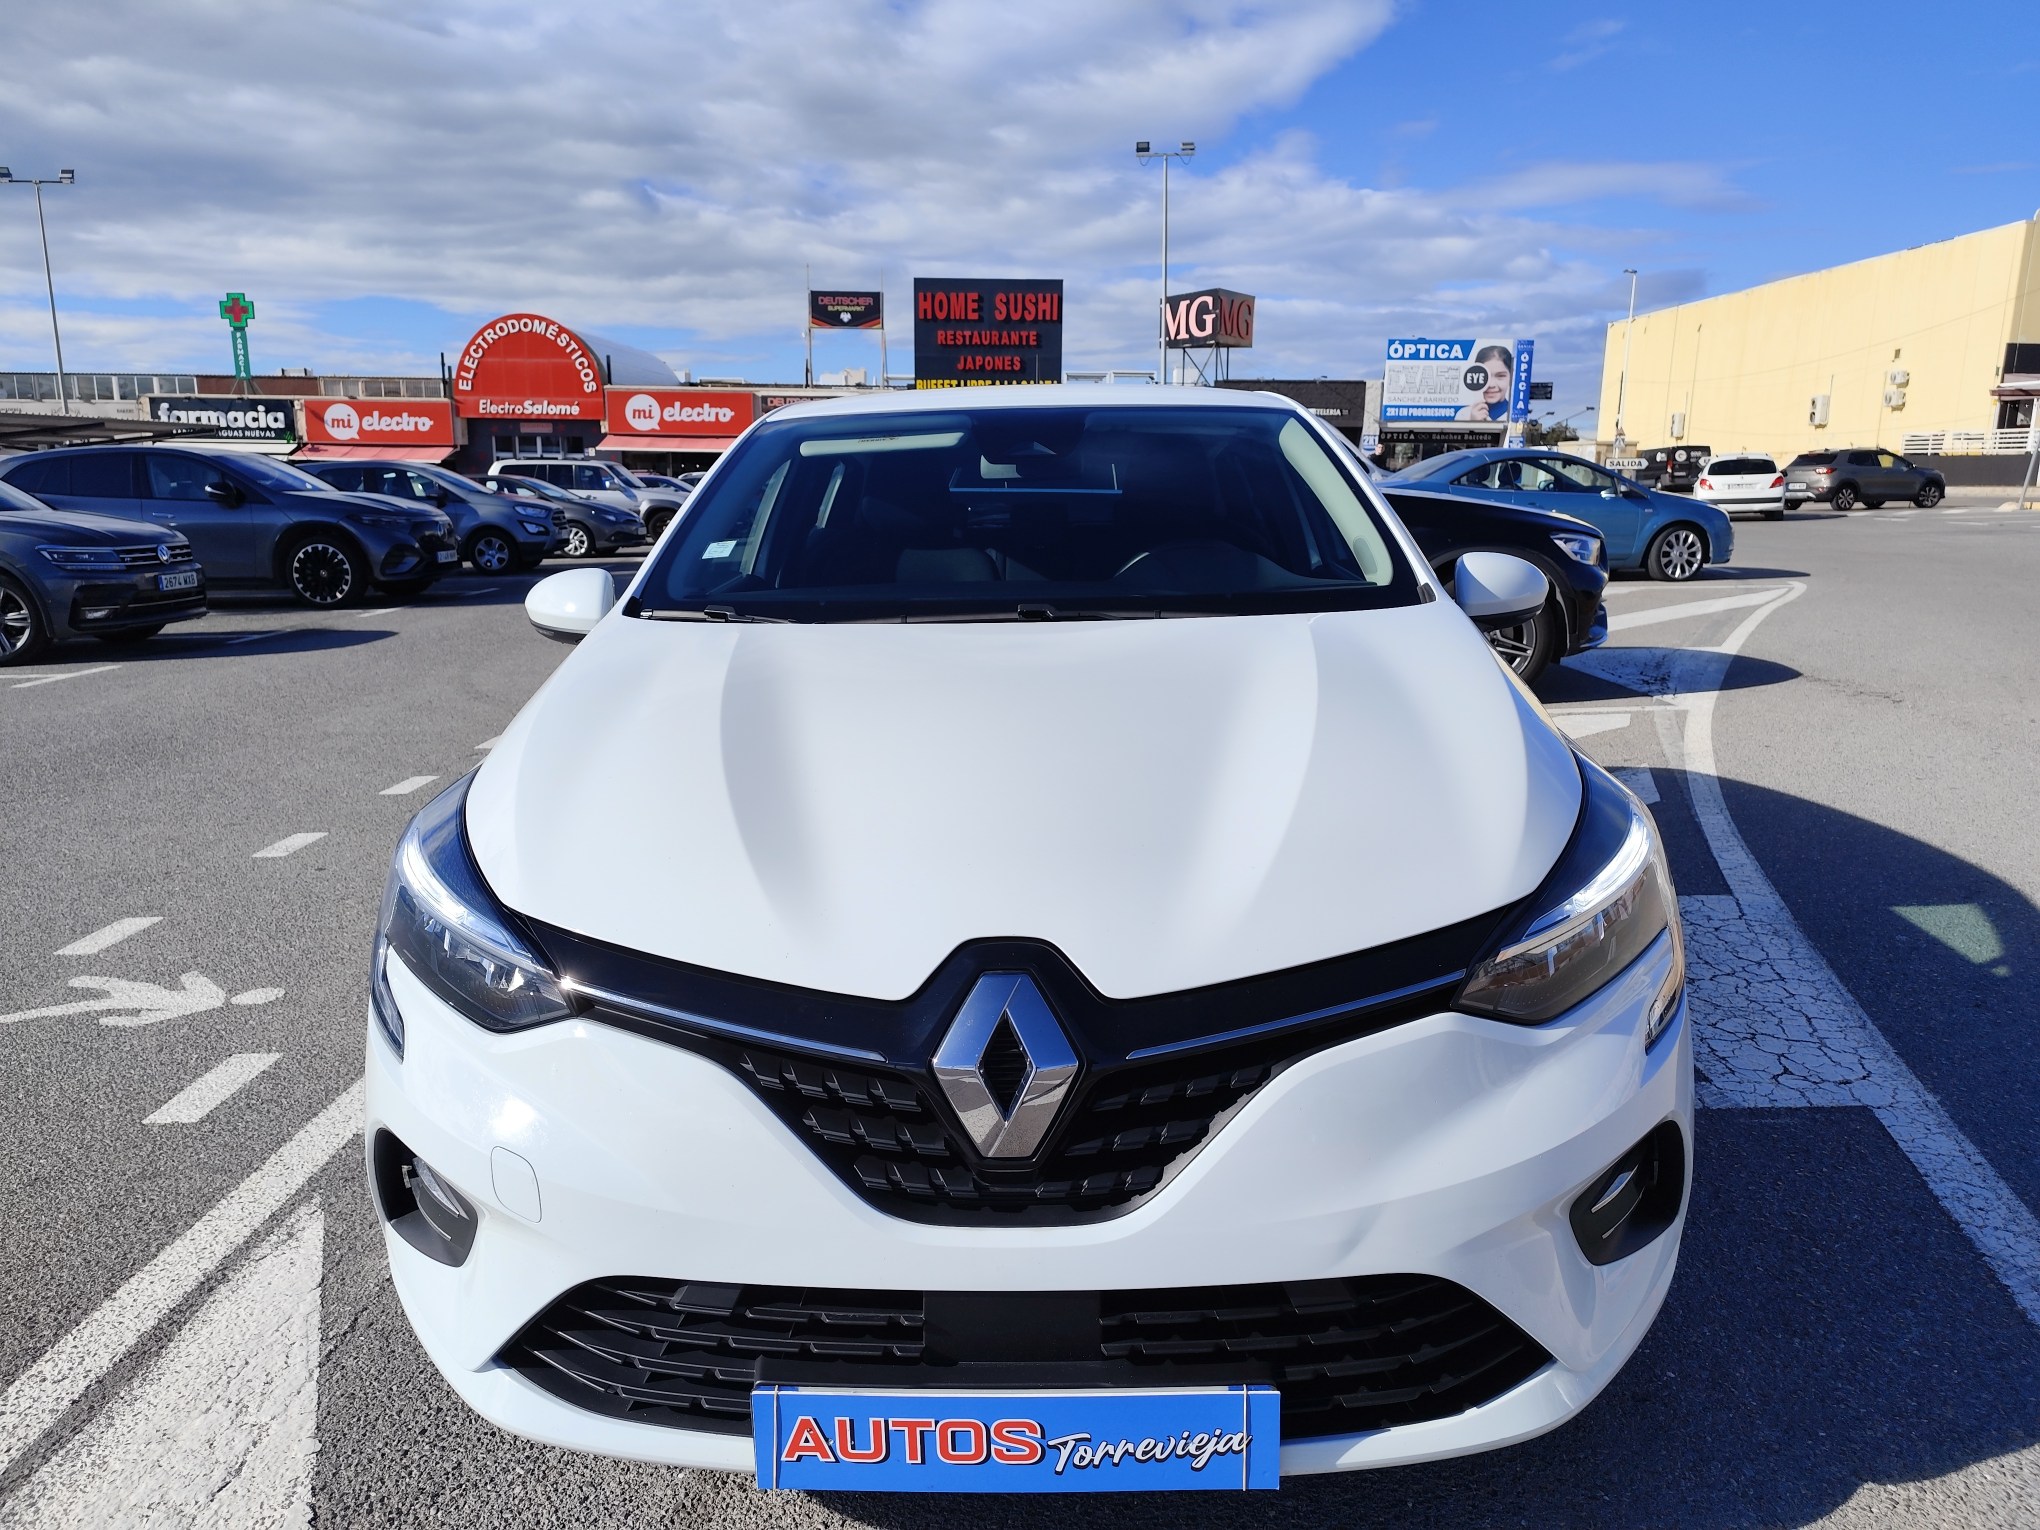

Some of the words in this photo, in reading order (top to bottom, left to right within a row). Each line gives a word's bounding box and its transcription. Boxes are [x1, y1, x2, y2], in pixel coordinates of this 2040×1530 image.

[818, 296, 873, 305] DEUTSCHER
[918, 292, 979, 320] HOME
[994, 292, 1059, 321] SUSHI
[1165, 295, 1216, 341] MG
[1219, 295, 1252, 340] MG
[937, 330, 1038, 346] RESTAURANTE
[236, 331, 247, 378] FARMACIA
[458, 318, 597, 394] ELECTRODOMÉSTICOS
[1388, 340, 1464, 359] ÓPTICA
[956, 355, 1021, 371] JAPONES
[1466, 372, 1485, 384] EYE
[158, 402, 286, 429] farmacia
[478, 399, 580, 416] ElectroSalomé
[632, 404, 655, 420] mi
[662, 401, 735, 423] electro
[1408, 407, 1456, 417] PROGRESIVOS
[331, 413, 354, 429] mi
[361, 410, 434, 432] electro
[244, 429, 276, 438] NUEVAS
[1609, 460, 1643, 468] SALIDA
[781, 1416, 1043, 1465] AUTOS
[1048, 1428, 1252, 1475] Torrevieja
